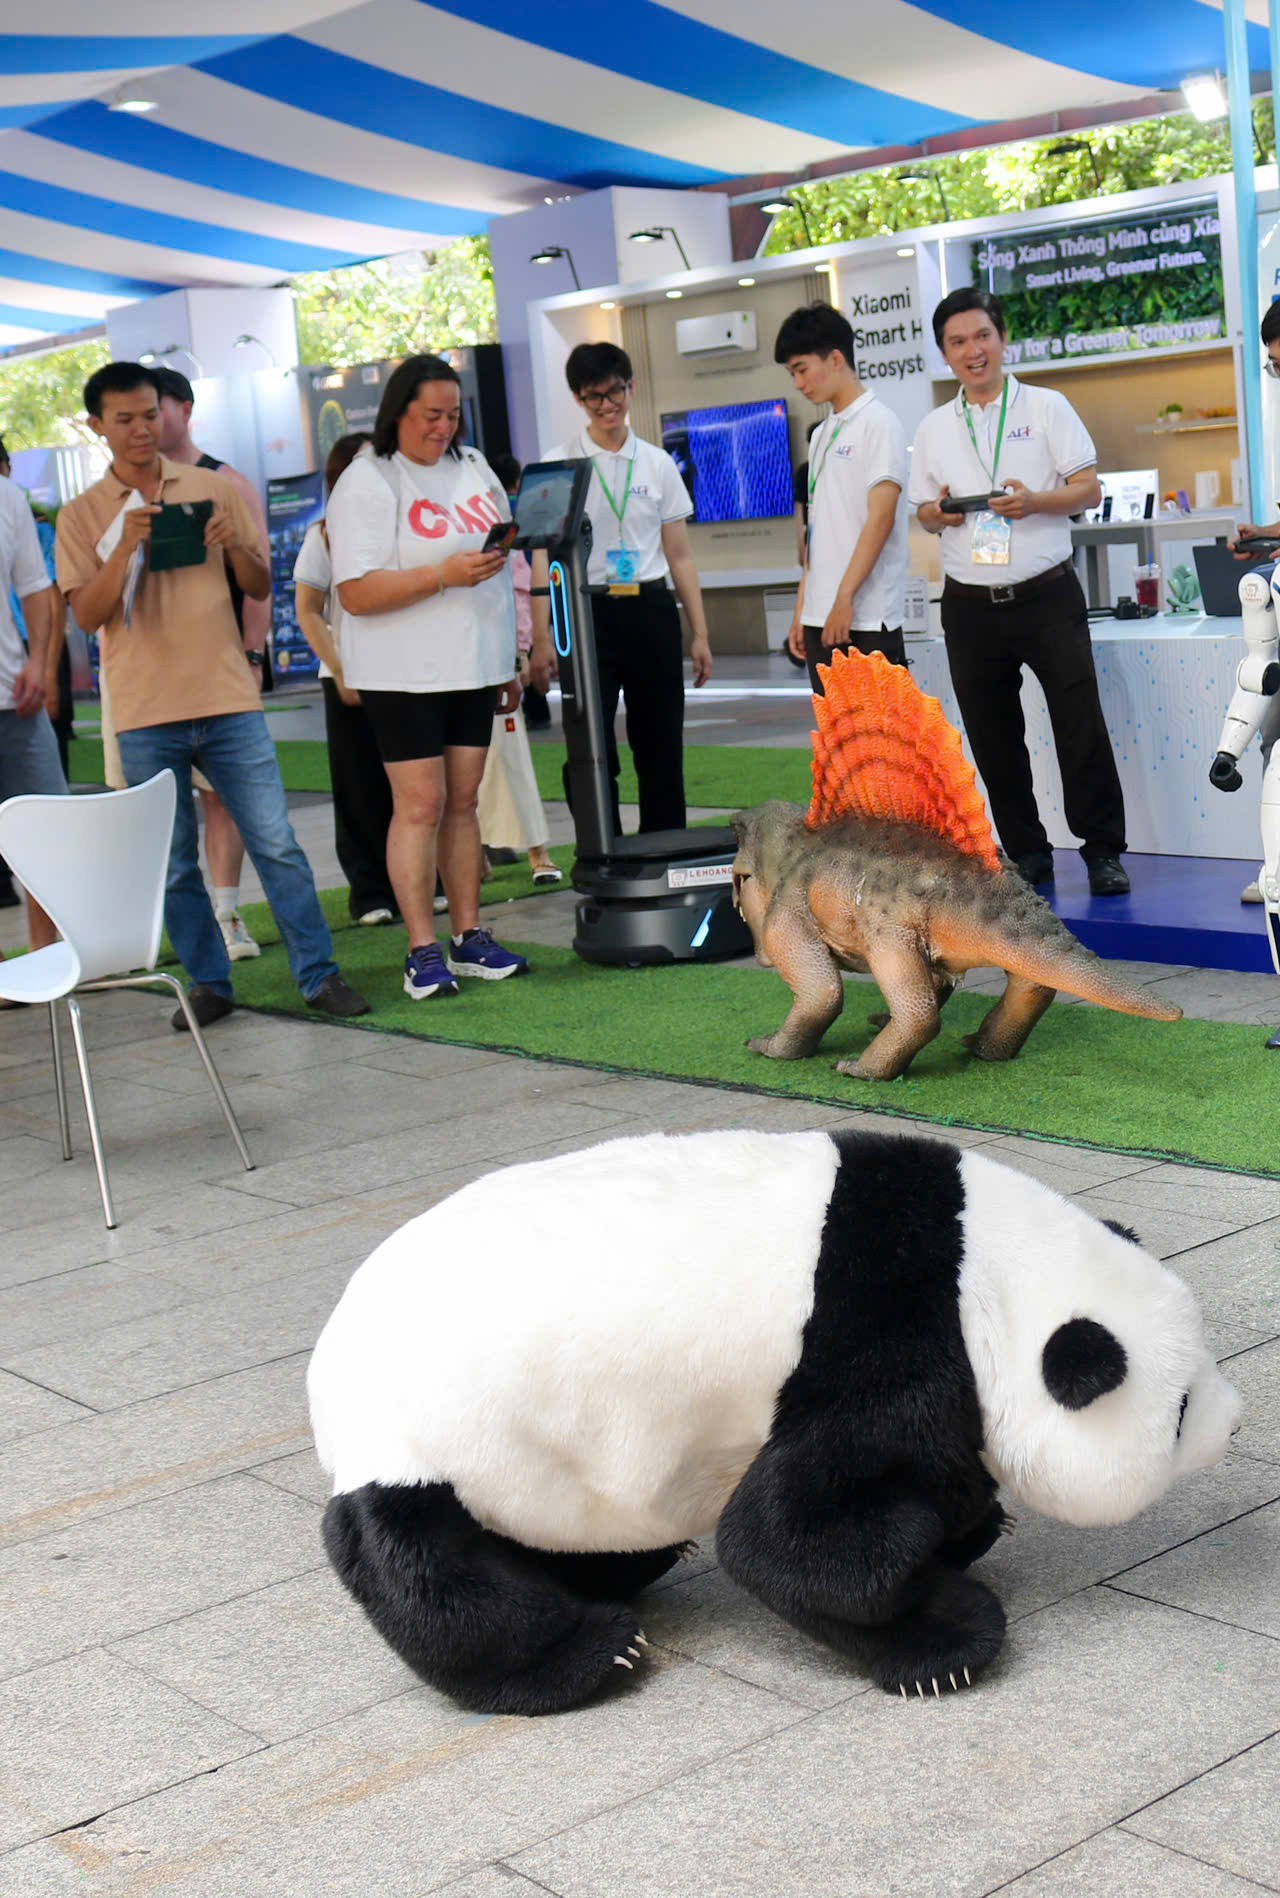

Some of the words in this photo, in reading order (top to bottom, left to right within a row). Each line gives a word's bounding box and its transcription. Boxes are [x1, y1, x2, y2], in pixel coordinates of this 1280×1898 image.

[1018, 241, 1056, 264] Xanh
[1193, 216, 1221, 238] Xia
[852, 286, 911, 317] Xiaomi
[854, 322, 906, 349] Smart
[911, 318, 923, 340] H
[1002, 343, 1022, 364] gy
[1051, 338, 1063, 354] a
[858, 354, 924, 380] Ecosyst
